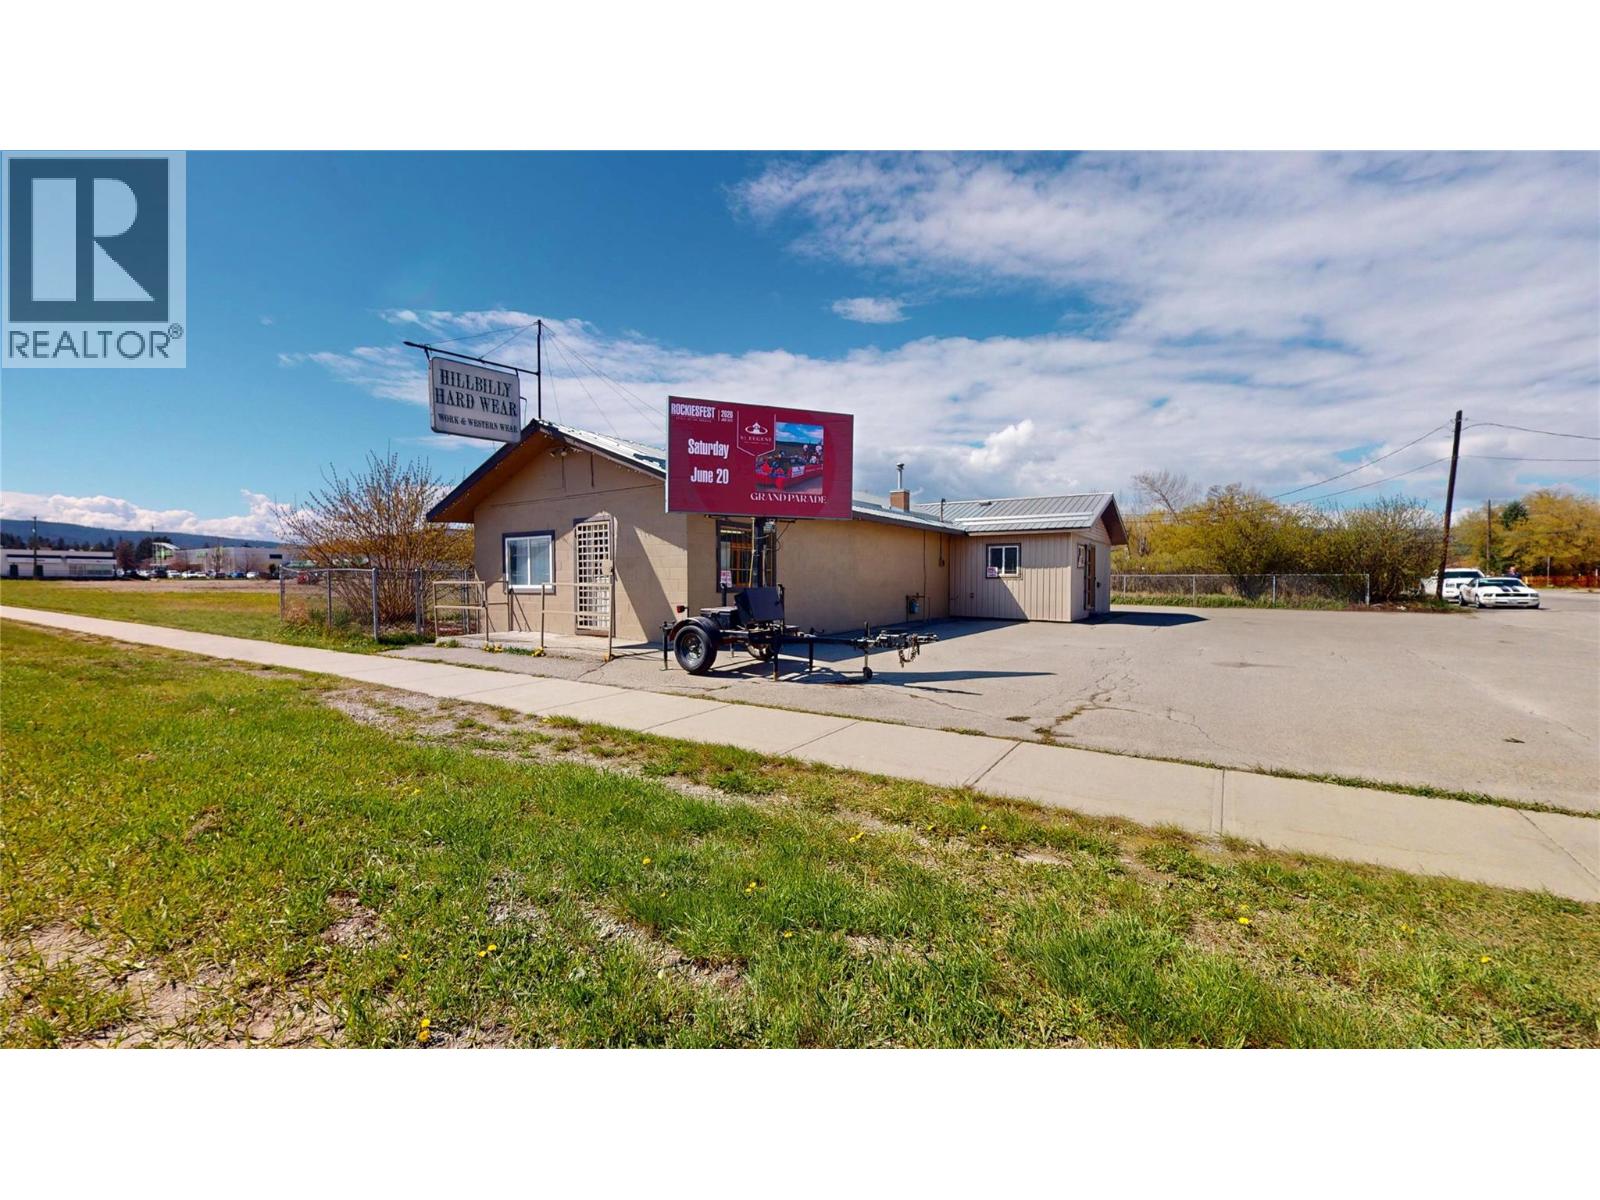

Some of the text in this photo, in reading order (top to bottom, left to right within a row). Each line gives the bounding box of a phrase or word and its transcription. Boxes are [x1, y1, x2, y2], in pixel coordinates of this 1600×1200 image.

[440, 369, 511, 398] HILLBILLY
[435, 387, 517, 417] HARD WEAR
[671, 403, 716, 419] ROCKIESFEST
[438, 413, 518, 433] WORK & WESTERN WEAR
[688, 438, 729, 459] Saturday
[690, 466, 729, 484] June 20
[750, 493, 827, 504] GRAND PARADE
